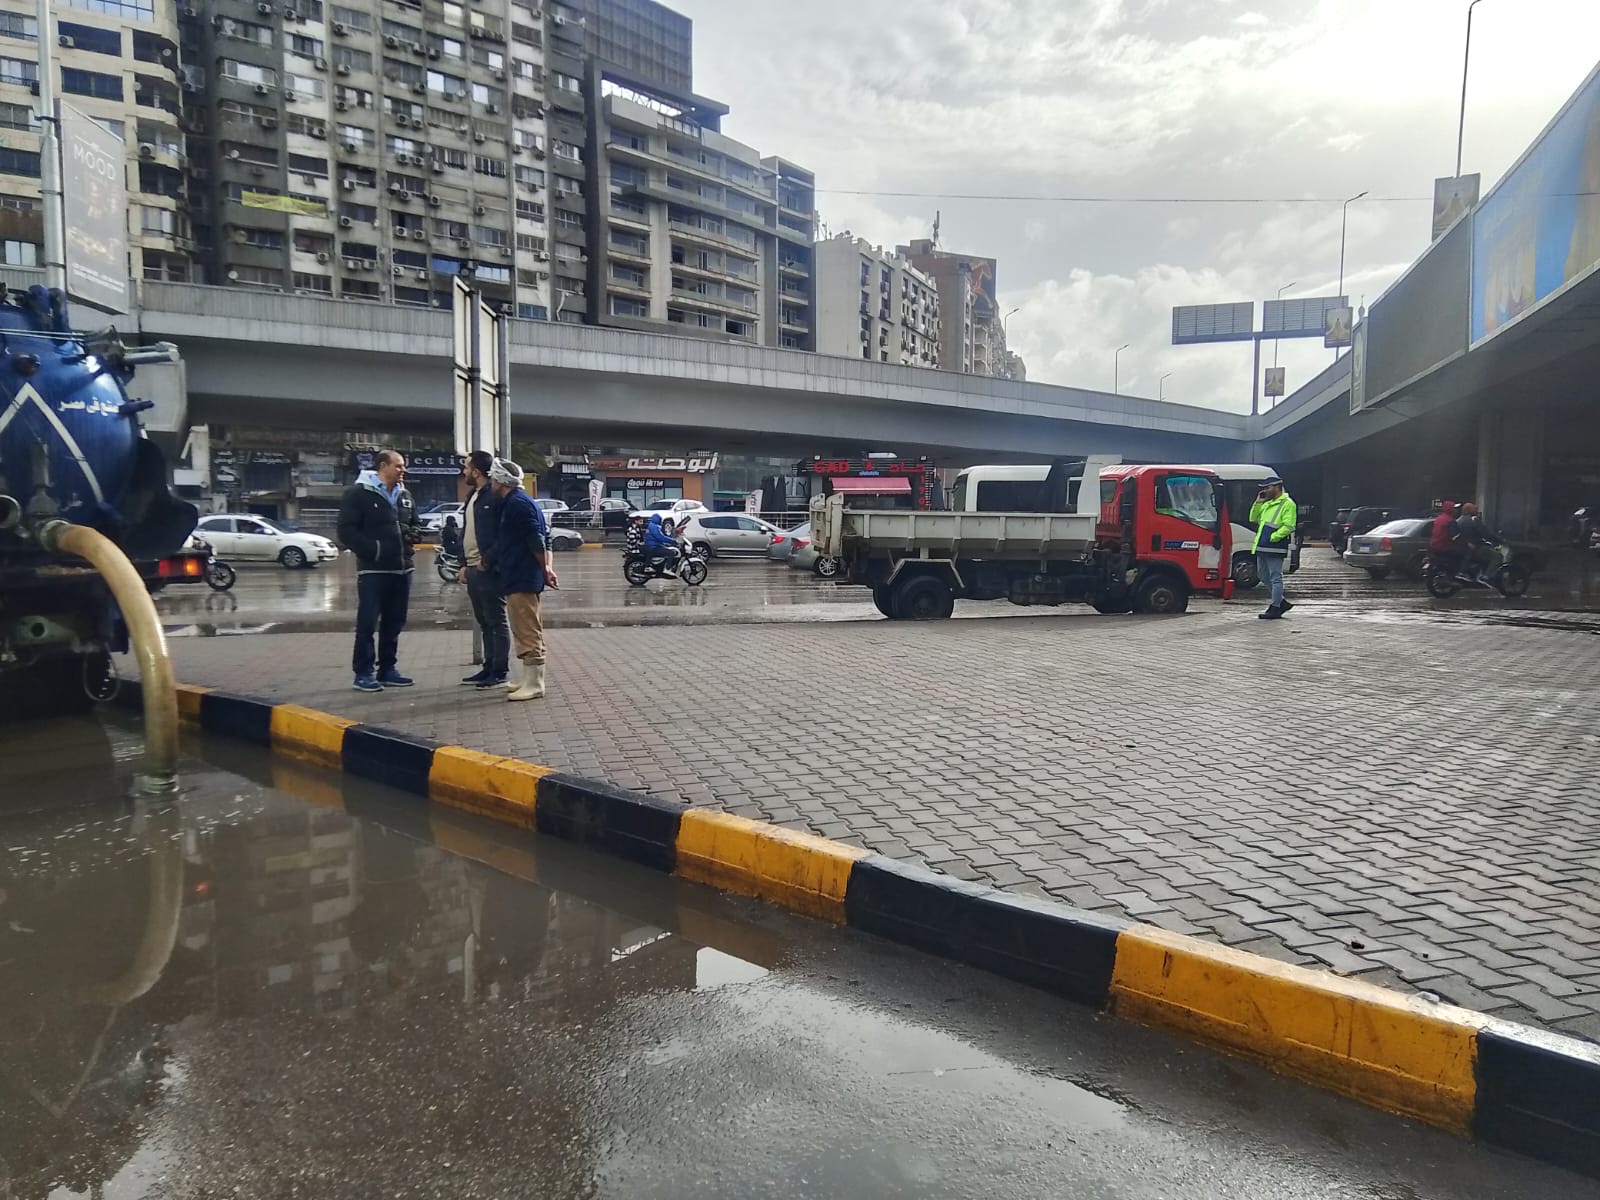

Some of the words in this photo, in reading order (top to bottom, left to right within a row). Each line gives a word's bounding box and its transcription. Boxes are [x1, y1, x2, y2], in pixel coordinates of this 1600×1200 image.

[74, 143, 116, 180] MOOD
[57, 400, 86, 412] مصر
[814, 461, 849, 472] GAD
